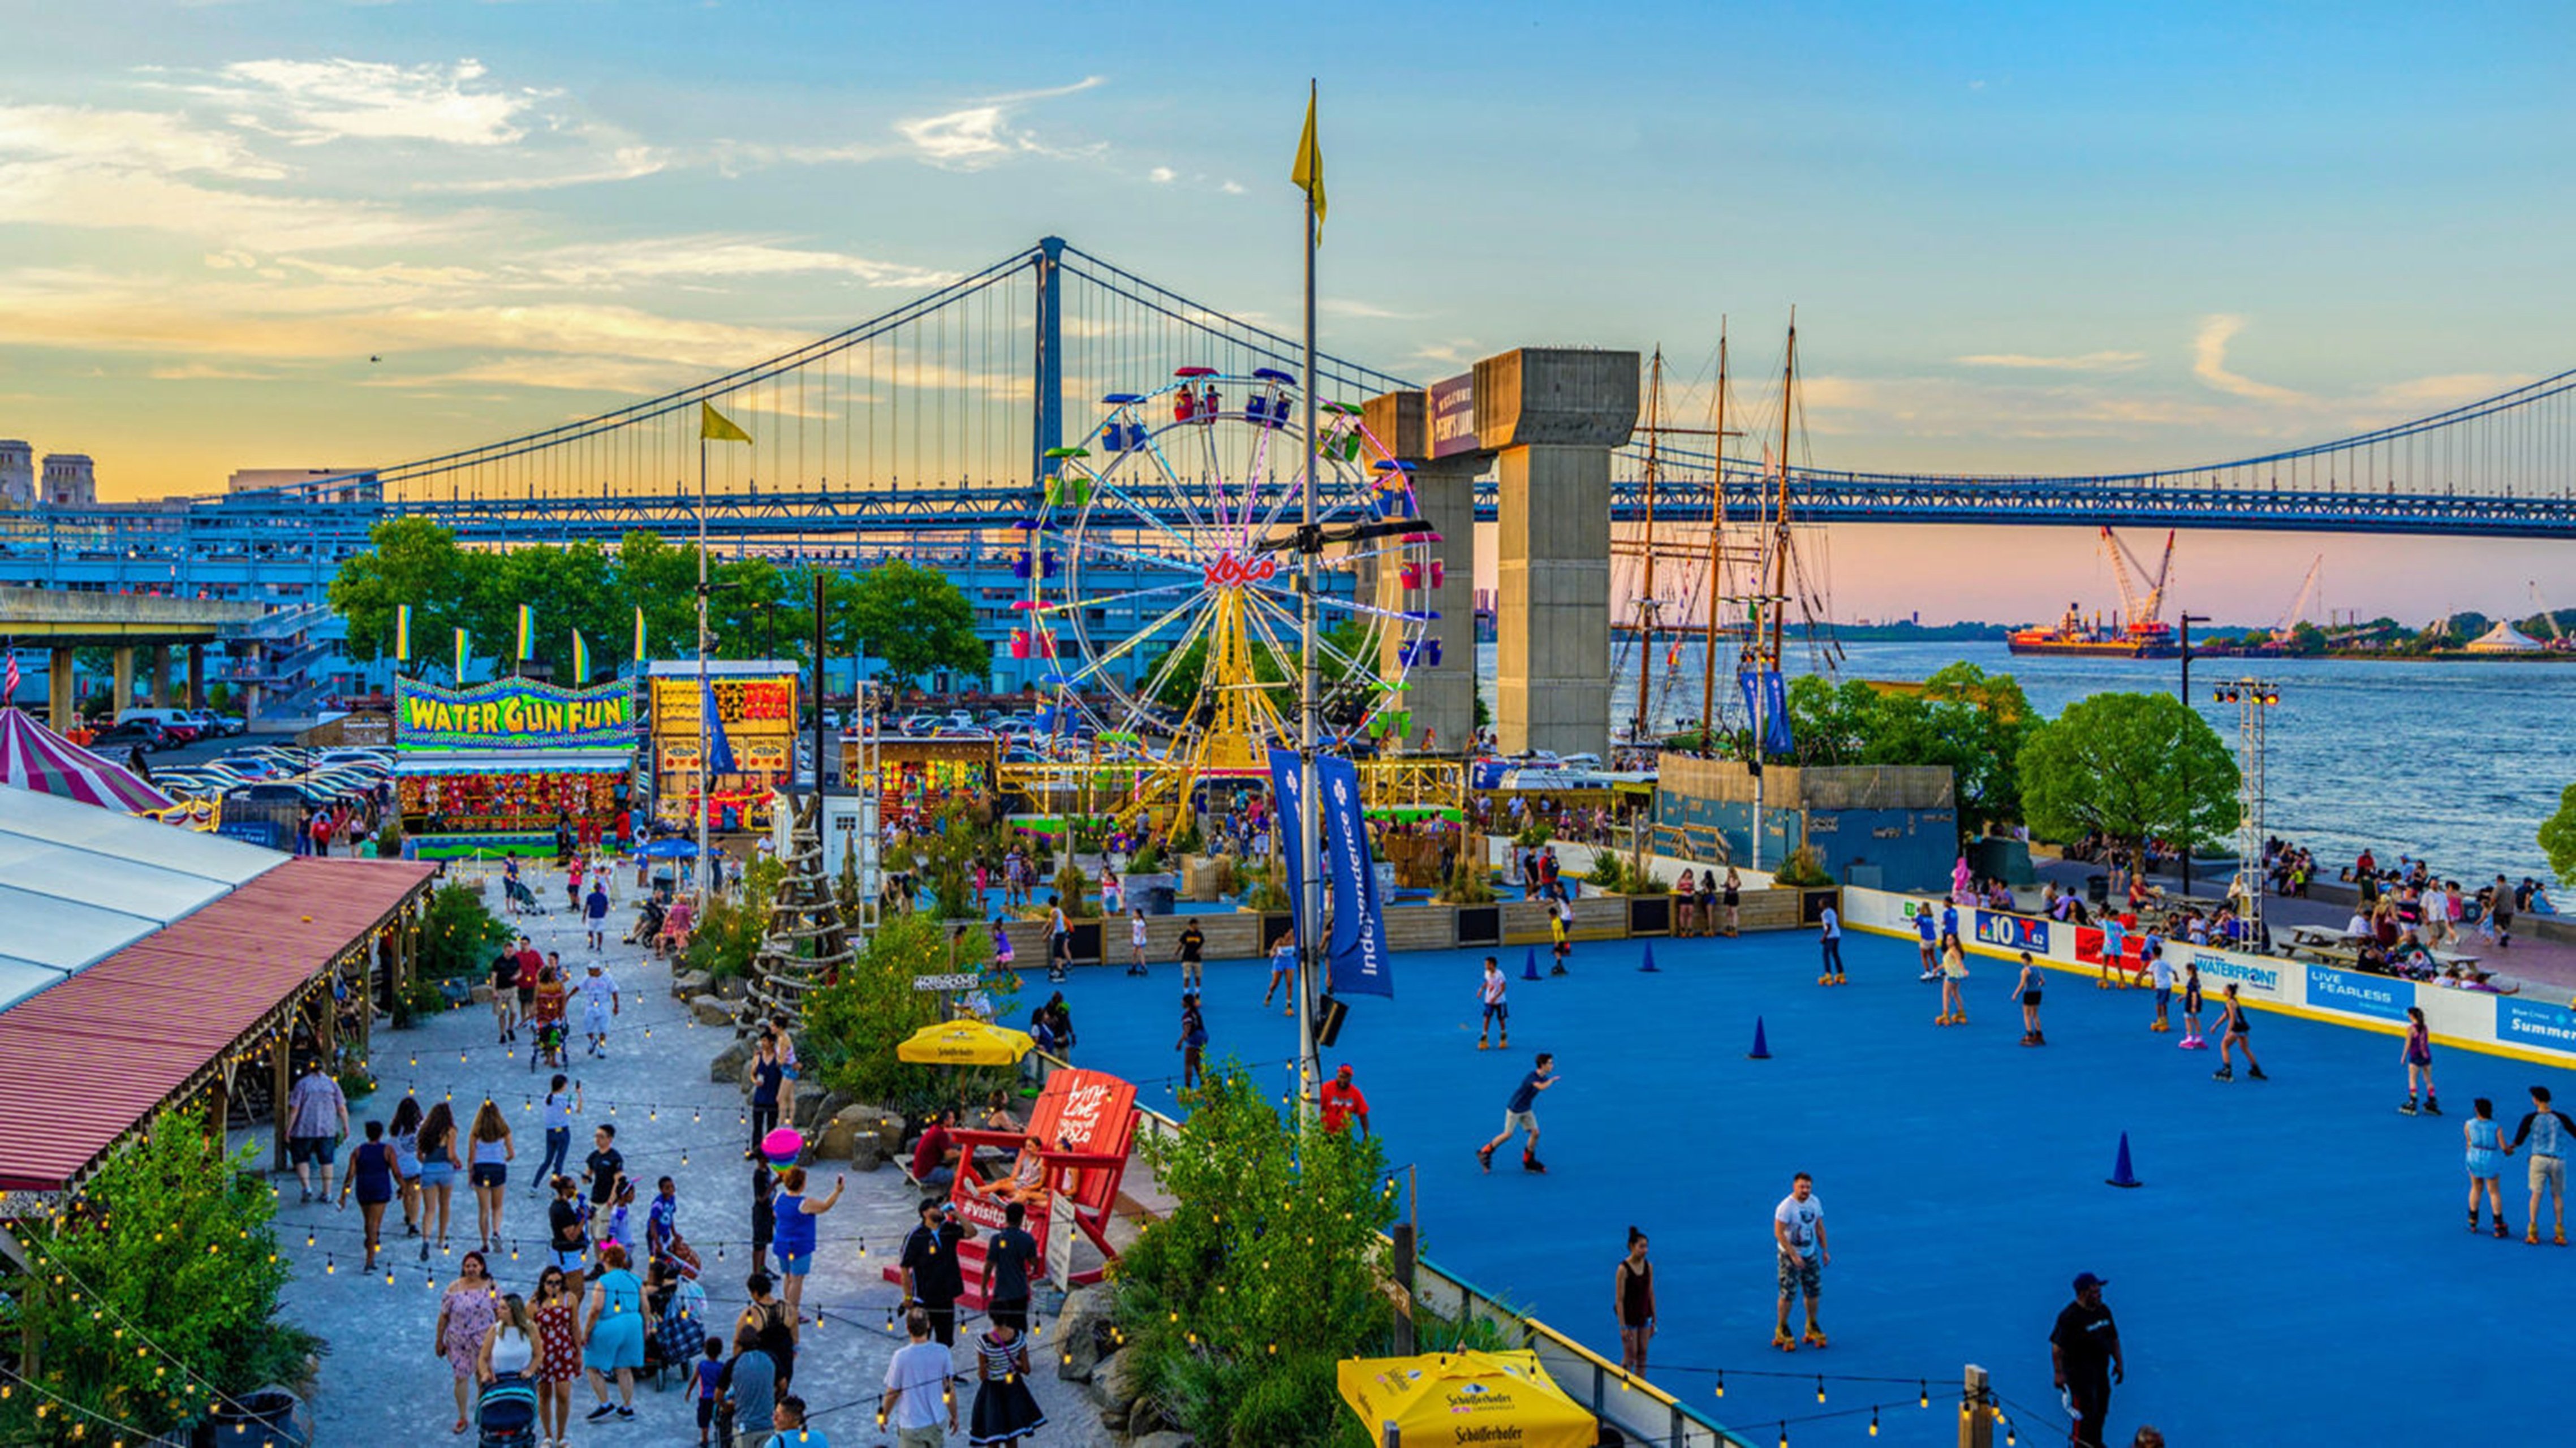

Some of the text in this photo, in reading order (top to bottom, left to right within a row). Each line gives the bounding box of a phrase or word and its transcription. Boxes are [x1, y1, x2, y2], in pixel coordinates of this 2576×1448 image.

[409, 696, 622, 734] WATER GUN FUN
[1341, 811, 1377, 976] Independence
[1990, 915, 2014, 945] 10
[2195, 958, 2277, 986] WATERFRONT
[2311, 971, 2341, 984] LIVE
[2319, 982, 2392, 1003] FEARLESS
[963, 1199, 1035, 1233] #visitply
